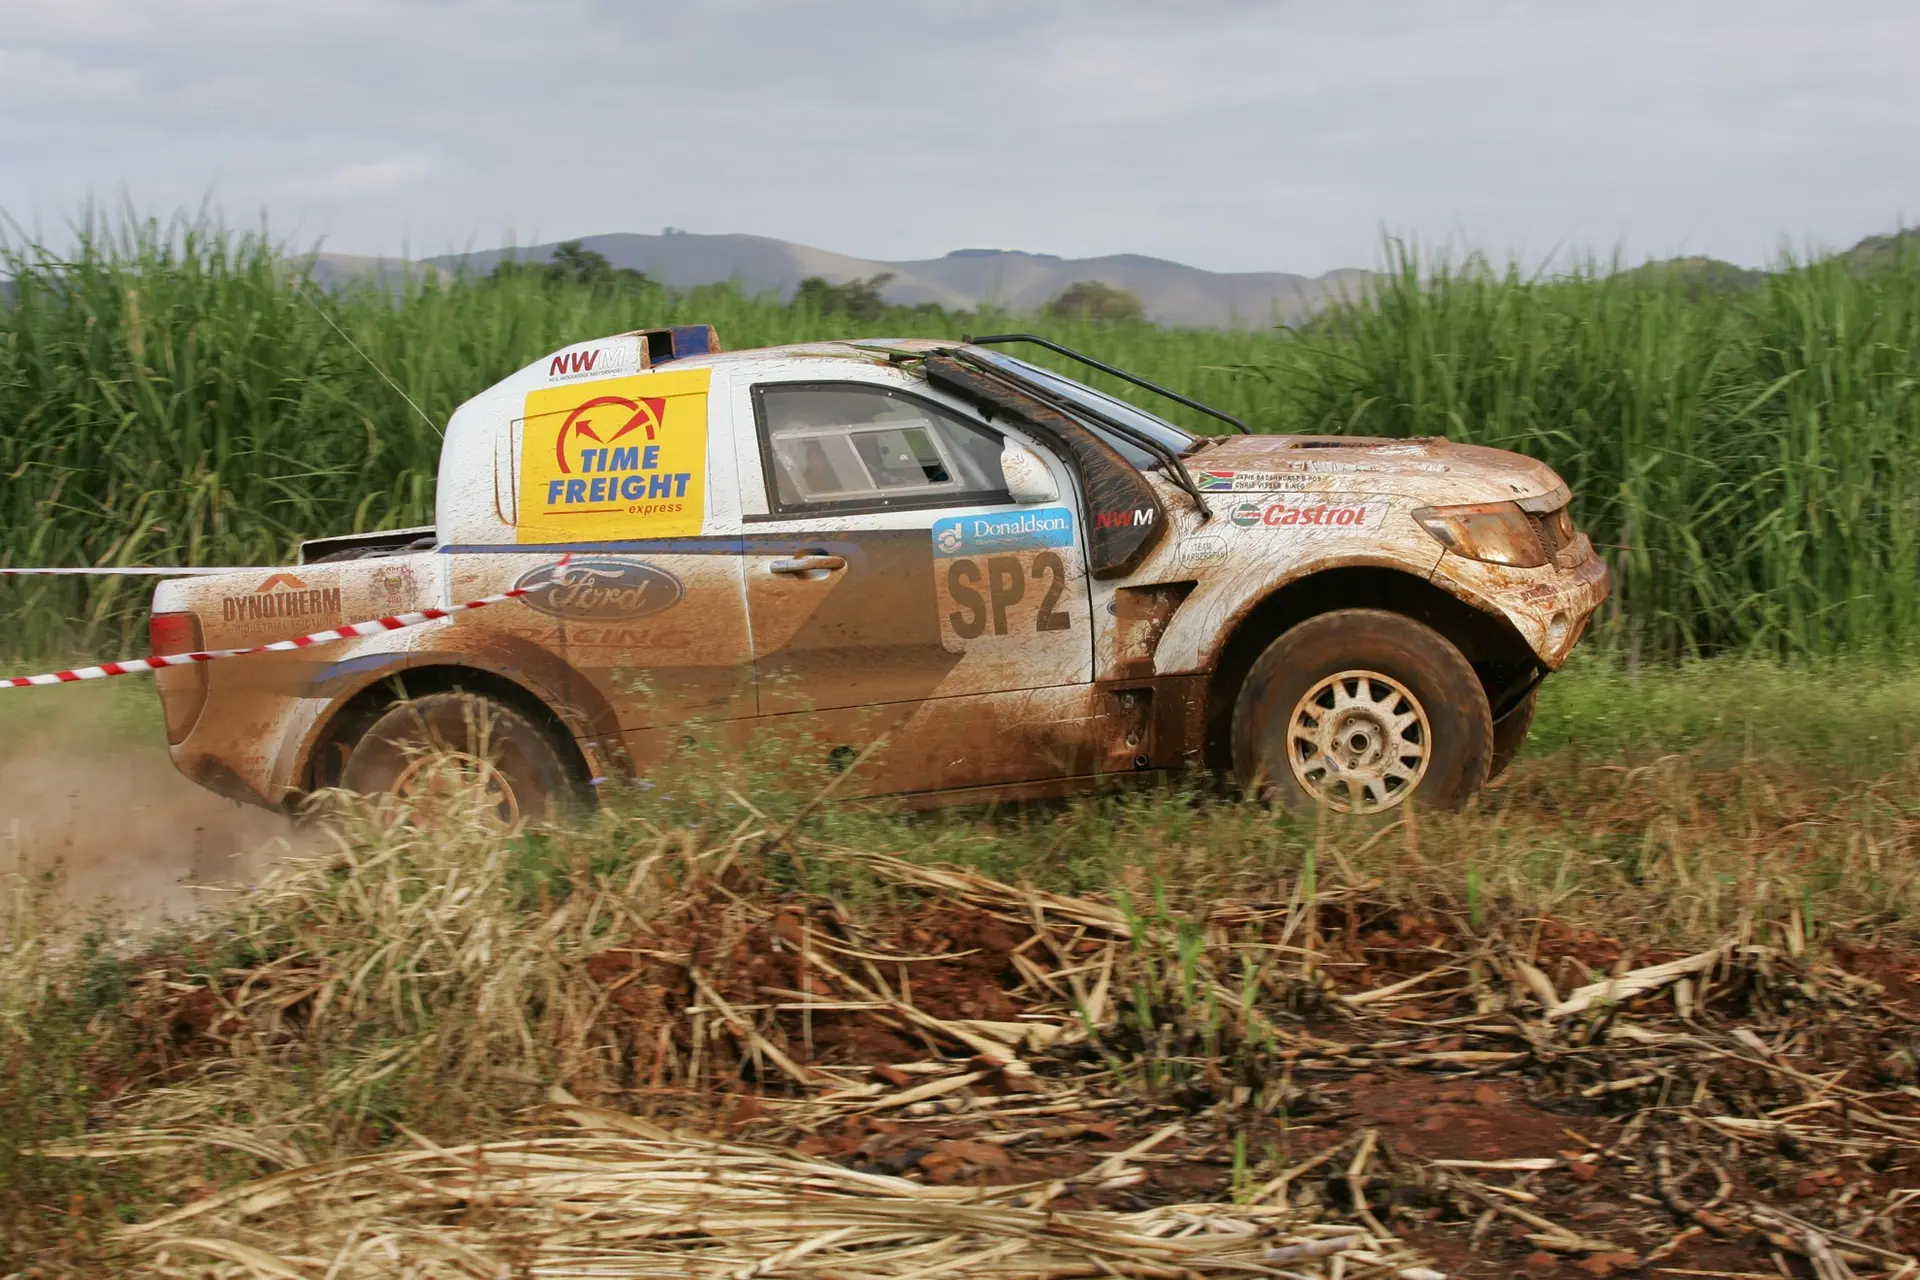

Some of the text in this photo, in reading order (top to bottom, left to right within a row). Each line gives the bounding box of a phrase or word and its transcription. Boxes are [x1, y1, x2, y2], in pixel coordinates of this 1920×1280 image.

[549, 346, 627, 377] NWM
[581, 445, 660, 473] TIME
[547, 473, 691, 505] FREIGHT
[628, 502, 683, 516] express
[1096, 508, 1154, 528] NWM
[1263, 503, 1367, 526] Castrol
[974, 514, 1066, 538] Donaldson
[549, 567, 649, 610] Ford
[947, 551, 1071, 640] SP2
[223, 587, 341, 622] DYNOTHERM
